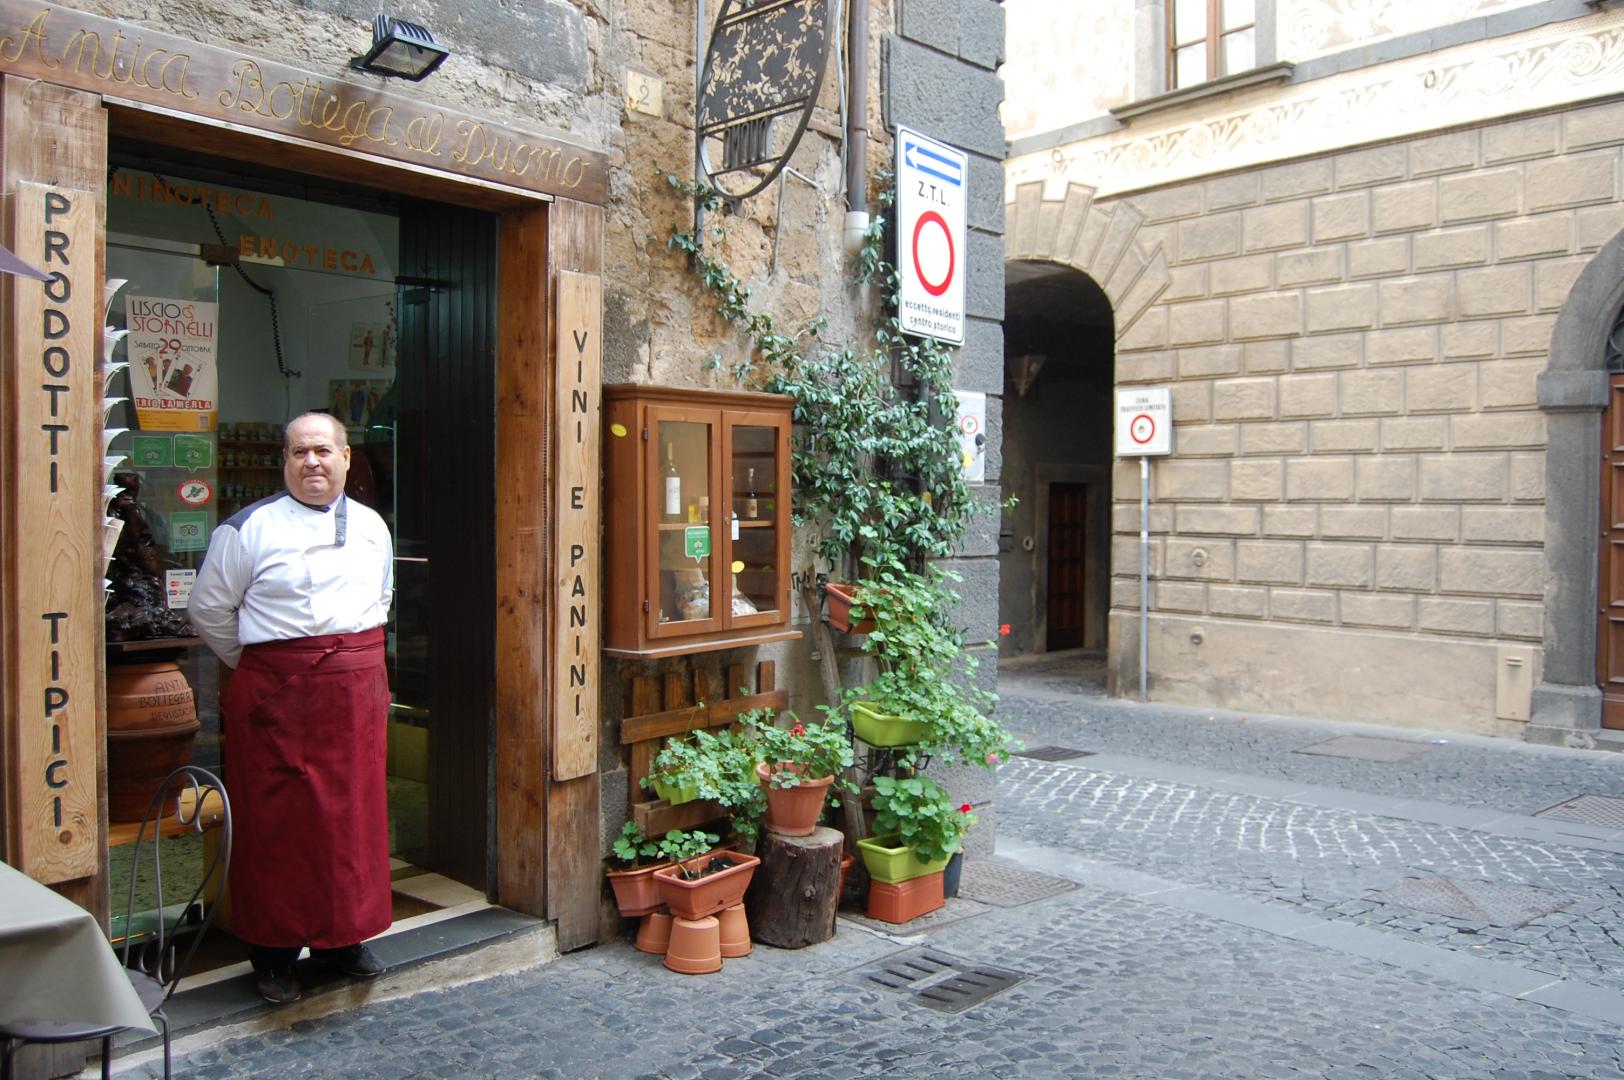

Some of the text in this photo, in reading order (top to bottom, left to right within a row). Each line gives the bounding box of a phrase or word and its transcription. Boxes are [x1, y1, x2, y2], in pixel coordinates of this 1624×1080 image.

[0, 8, 590, 188] Antica Bottega al Duomo
[639, 84, 650, 106] 2
[918, 180, 950, 207] Z.T.L.
[238, 235, 377, 275] ENOTECA
[132, 300, 181, 319] LISCIO
[905, 300, 961, 322] eccetto residenti
[132, 316, 214, 338] STORNELLI
[909, 314, 957, 335] centro storico
[159, 337, 182, 355] 29
[41, 192, 71, 828] PRODOTTI TIPICI
[570, 329, 588, 717] VINI E PANINI
